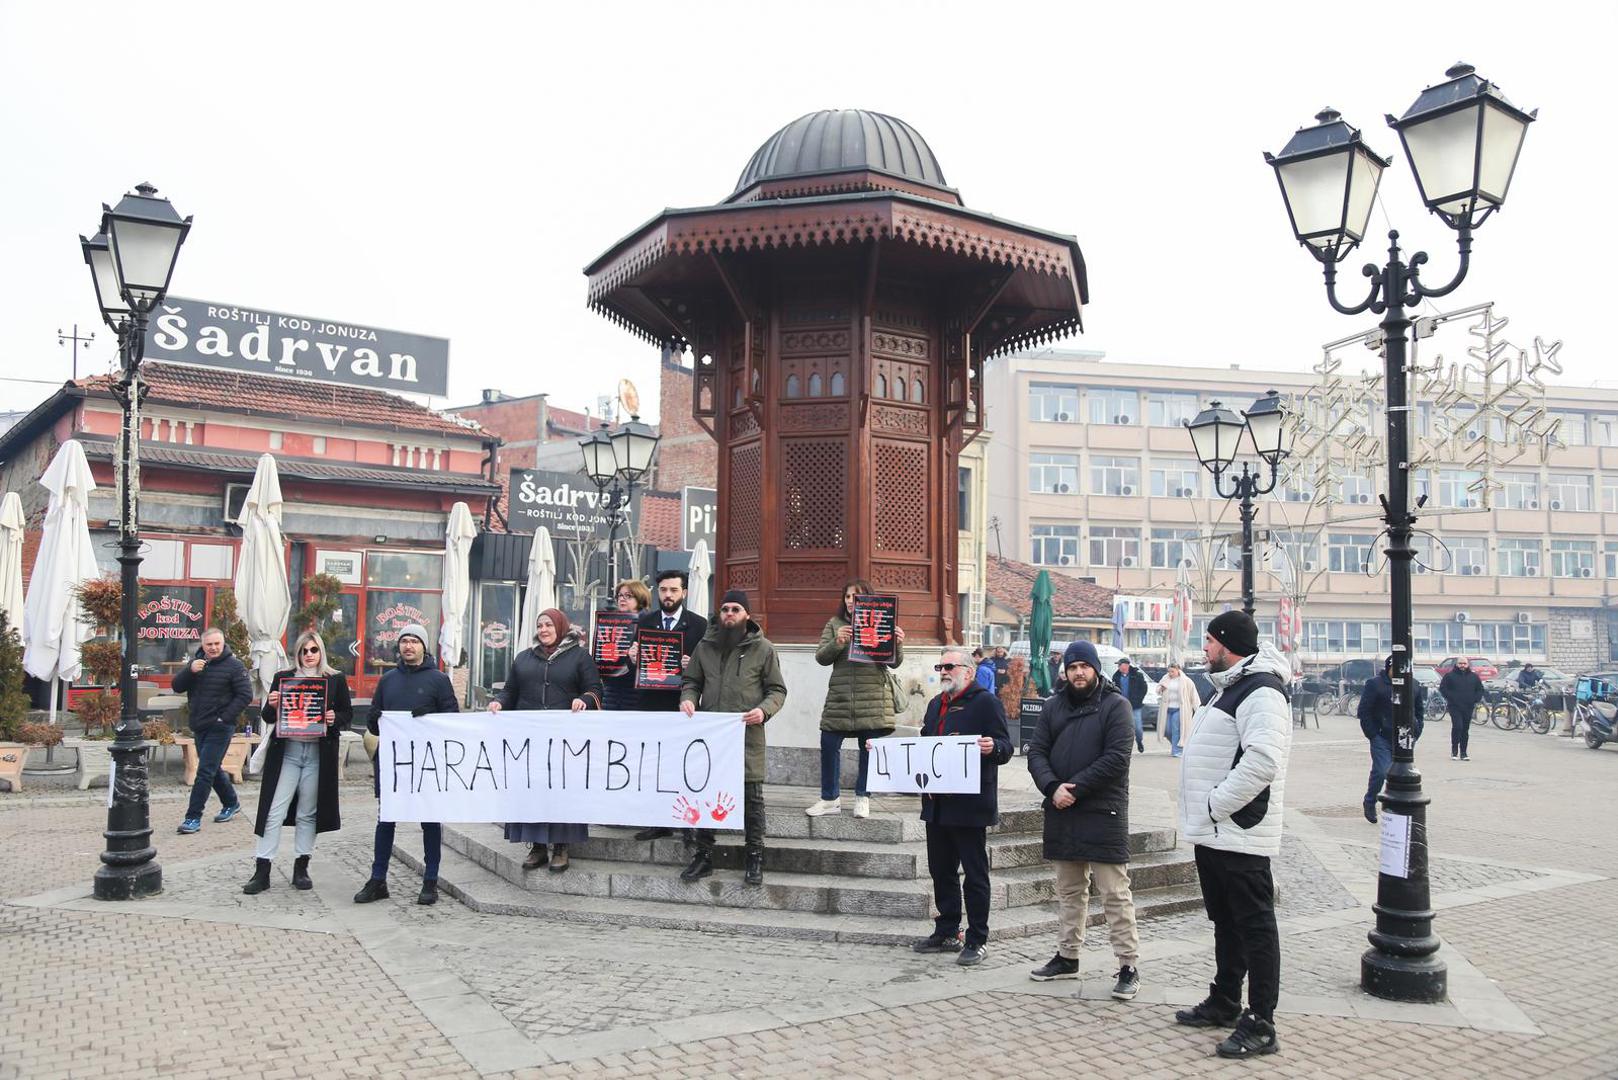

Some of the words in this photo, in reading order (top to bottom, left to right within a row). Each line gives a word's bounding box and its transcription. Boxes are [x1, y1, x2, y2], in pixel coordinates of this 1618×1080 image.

[208, 306, 271, 325] ROŠTILJ
[278, 317, 311, 331] KOD
[317, 323, 378, 342] JONUZA
[153, 305, 418, 383] Šadrvan
[527, 508, 563, 520] ROŠTILJ
[566, 513, 586, 522] KOD
[156, 612, 180, 624] kod
[137, 627, 200, 639] JONUZA
